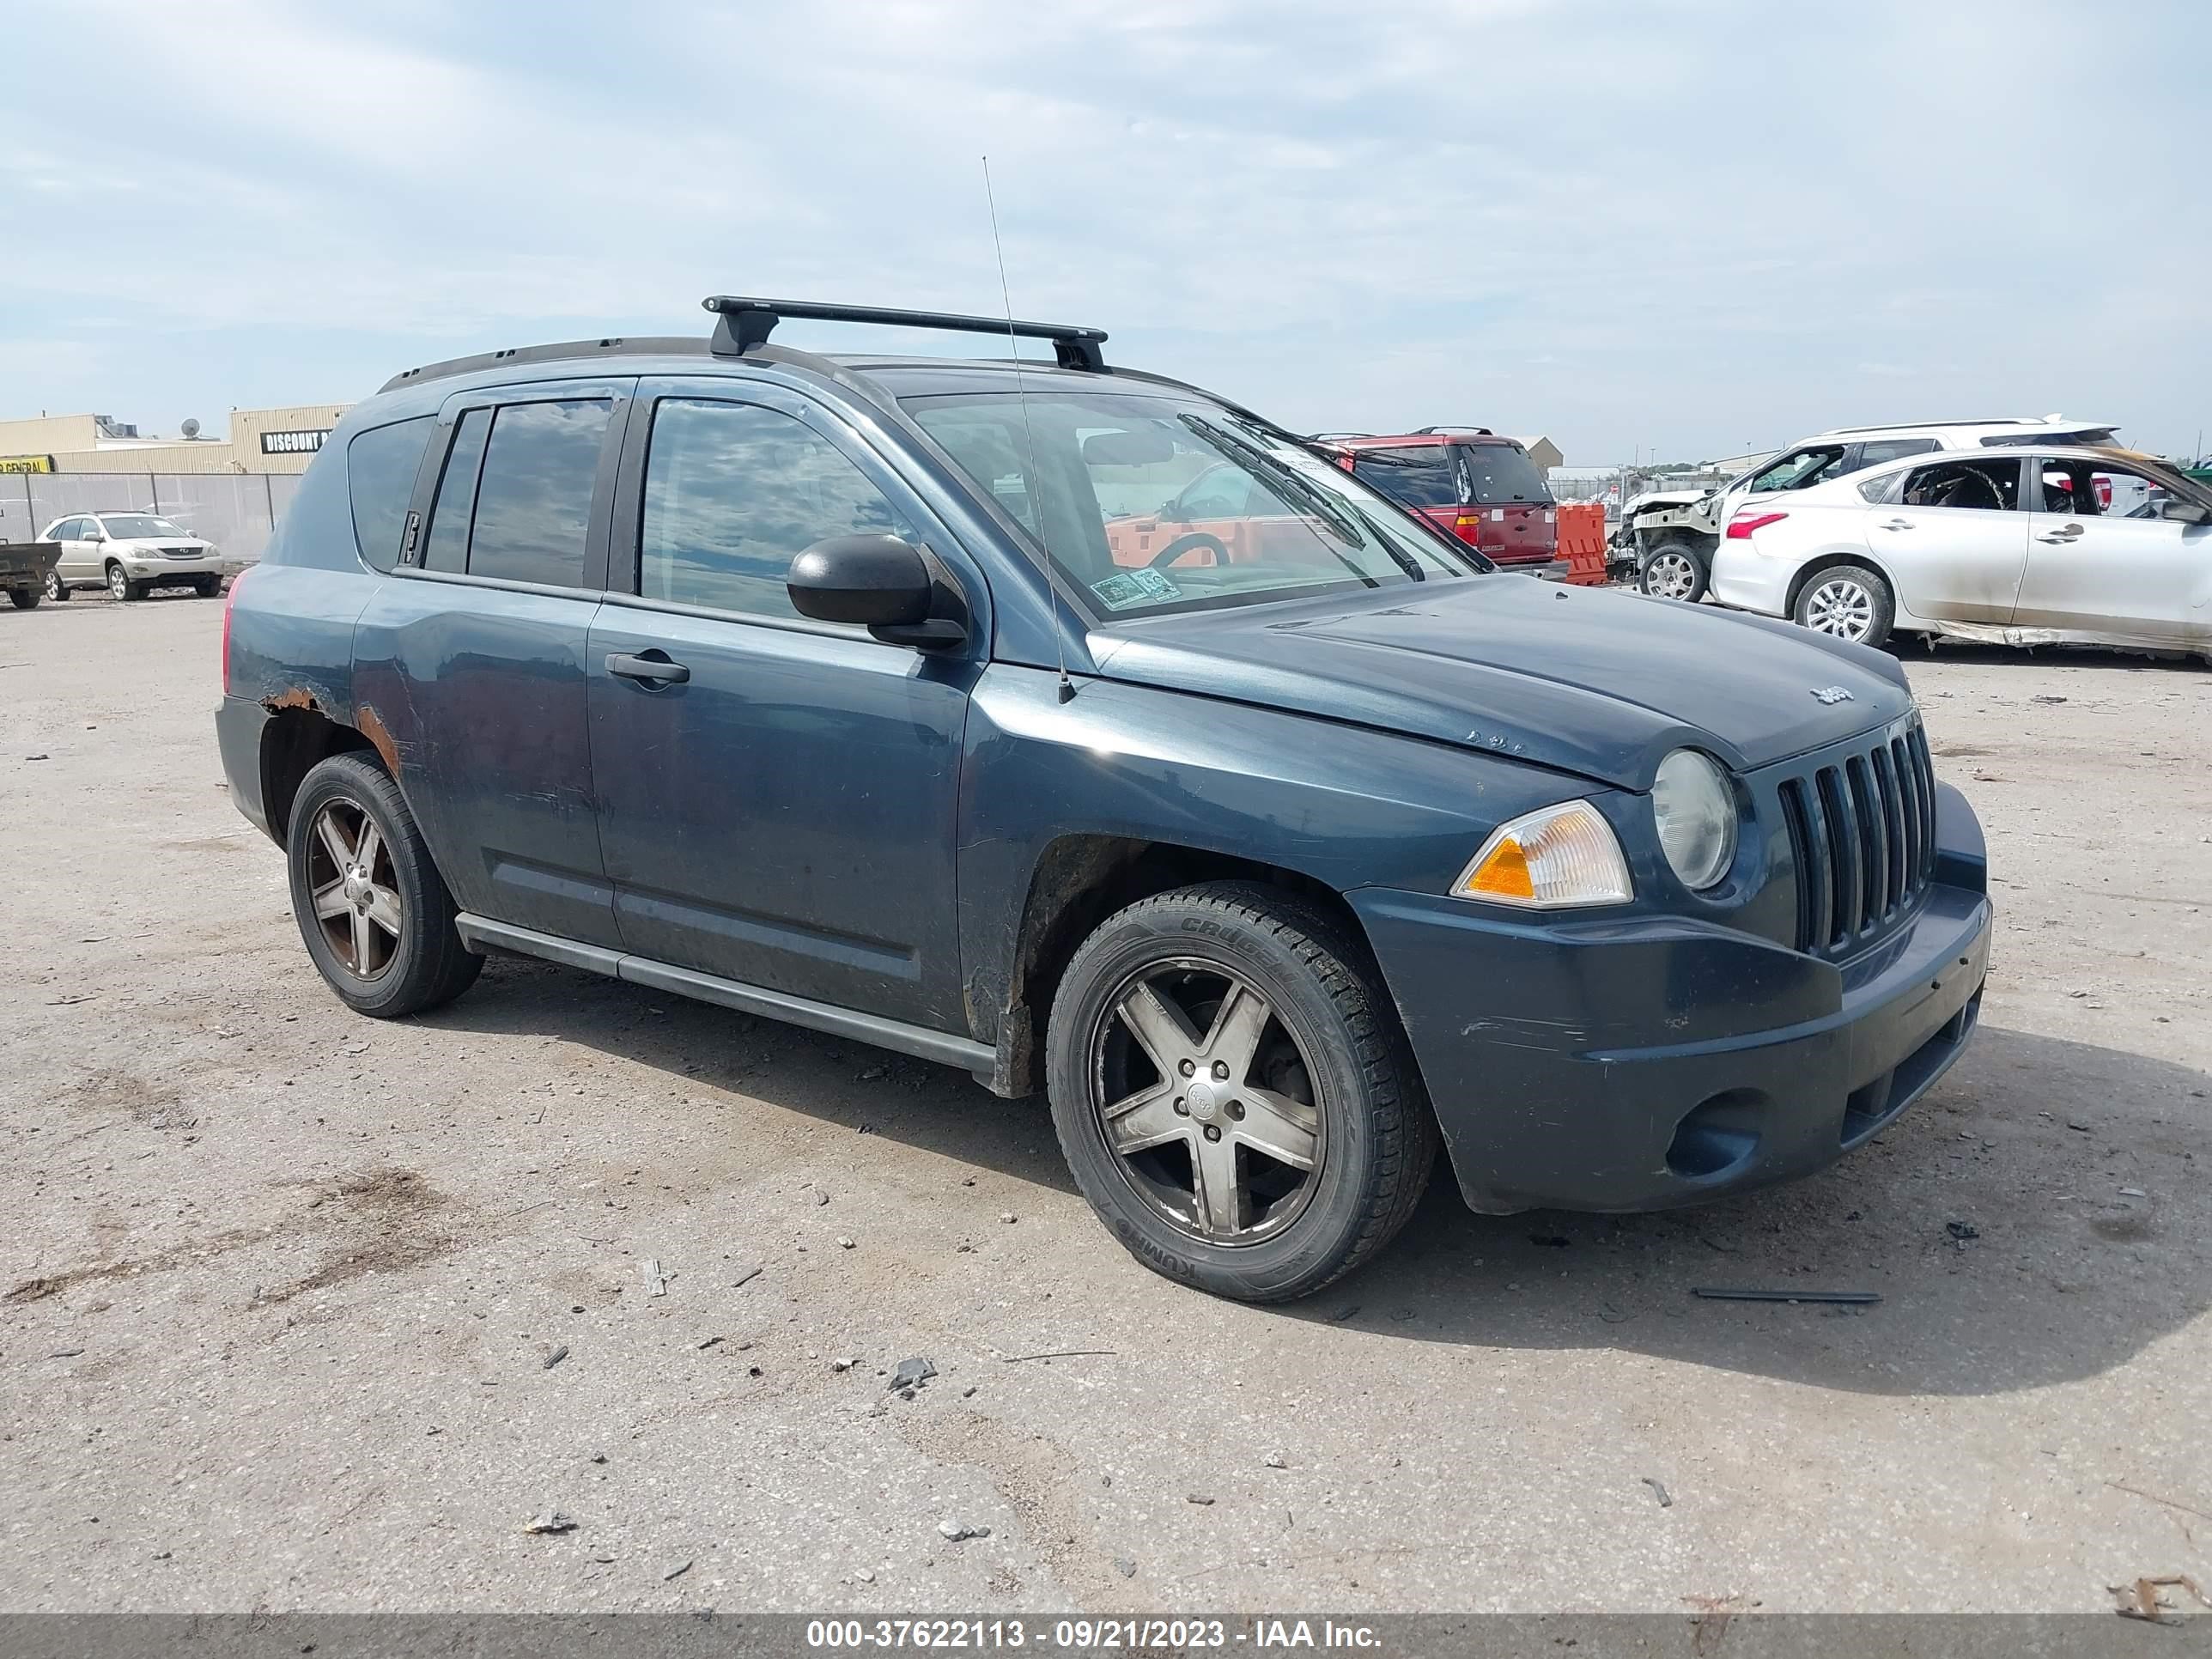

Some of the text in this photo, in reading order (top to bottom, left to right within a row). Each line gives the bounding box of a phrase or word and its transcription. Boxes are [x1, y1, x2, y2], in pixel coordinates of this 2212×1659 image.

[266, 432, 319, 452] DISCOUNT
[6, 461, 41, 472] GENERAL
[1181, 917, 1299, 983] CRUGEN
[1190, 1091, 1212, 1110] Jeep
[1115, 1218, 1196, 1279] KUMHO
